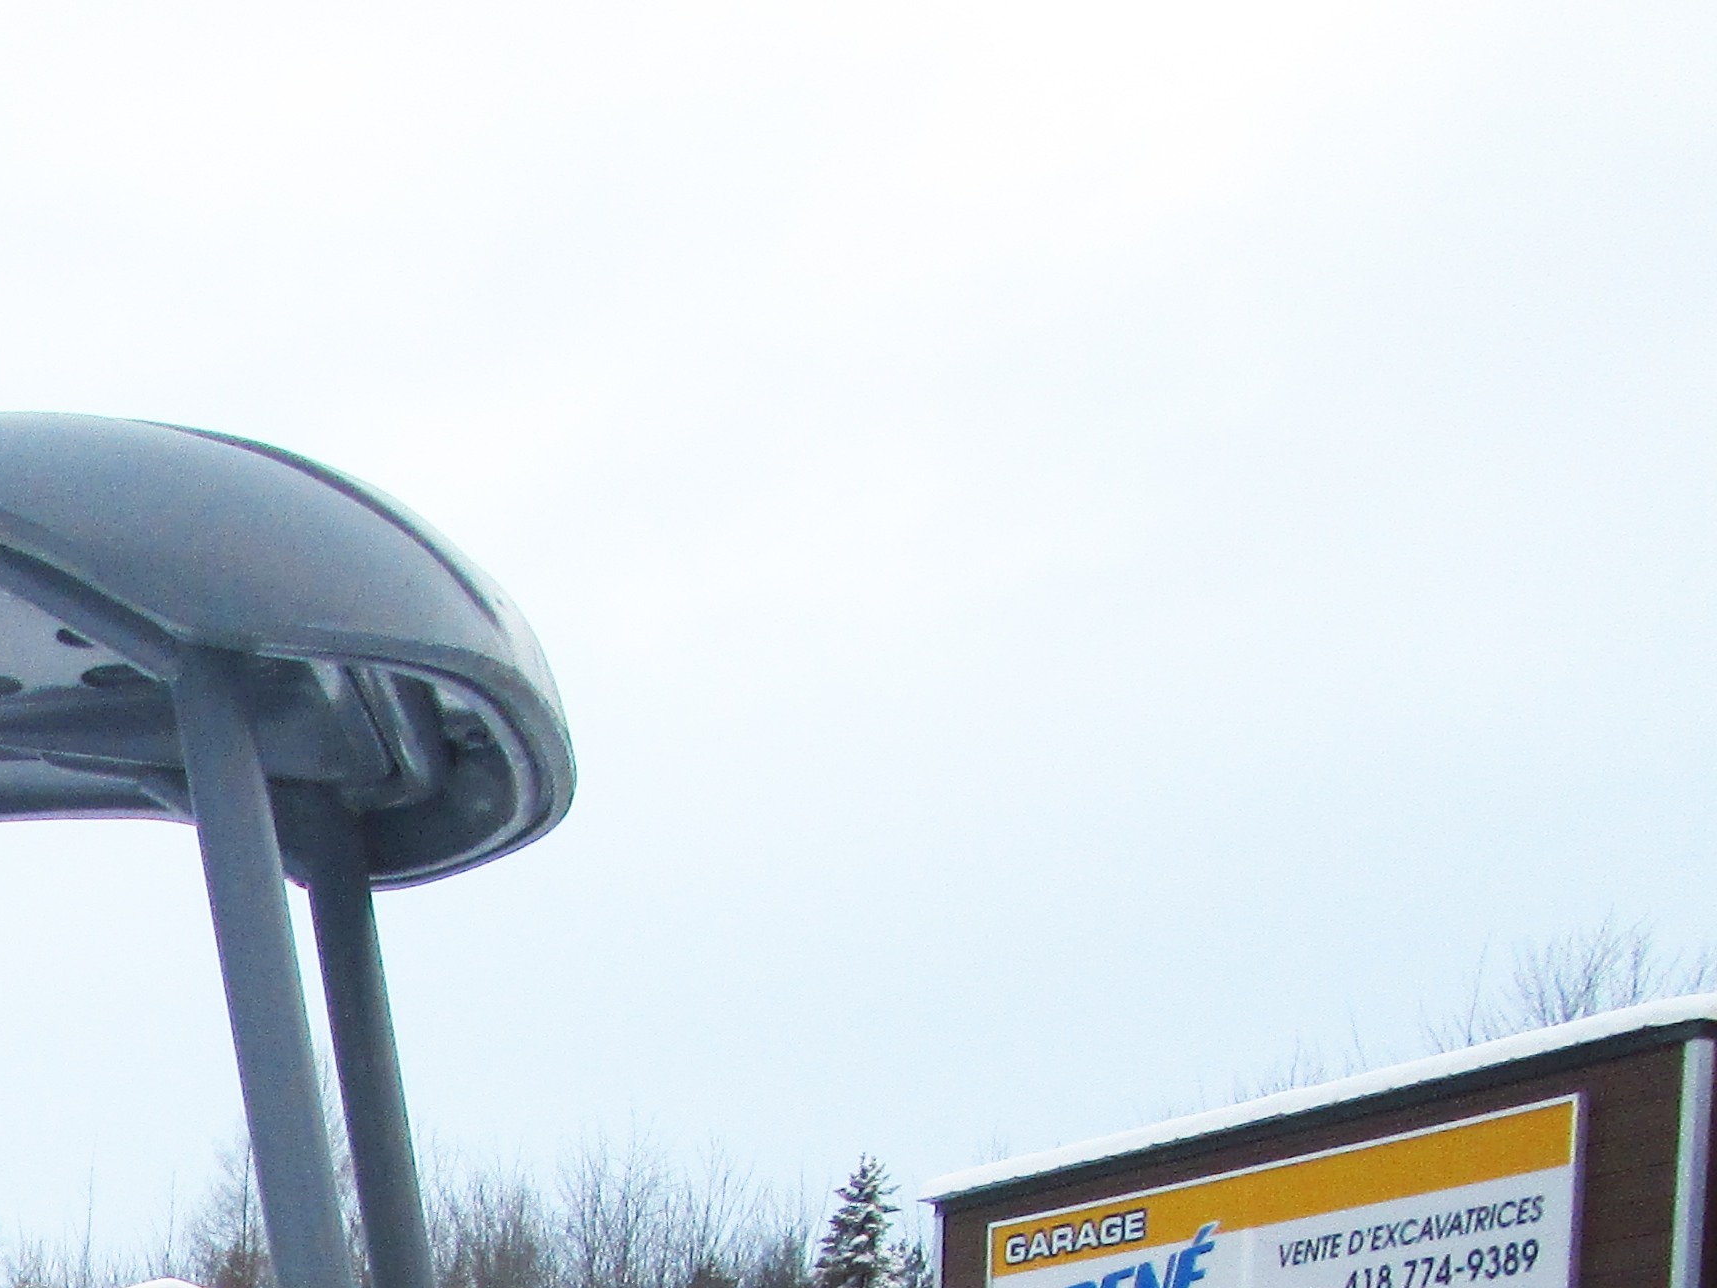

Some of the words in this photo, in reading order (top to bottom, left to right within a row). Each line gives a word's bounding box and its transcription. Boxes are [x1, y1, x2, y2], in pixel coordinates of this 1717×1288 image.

[1005, 1208, 1146, 1265] GARAGE
[1279, 1233, 1342, 1268] VENTE
[1348, 1196, 1545, 1257] D'EXCAVATRICES
